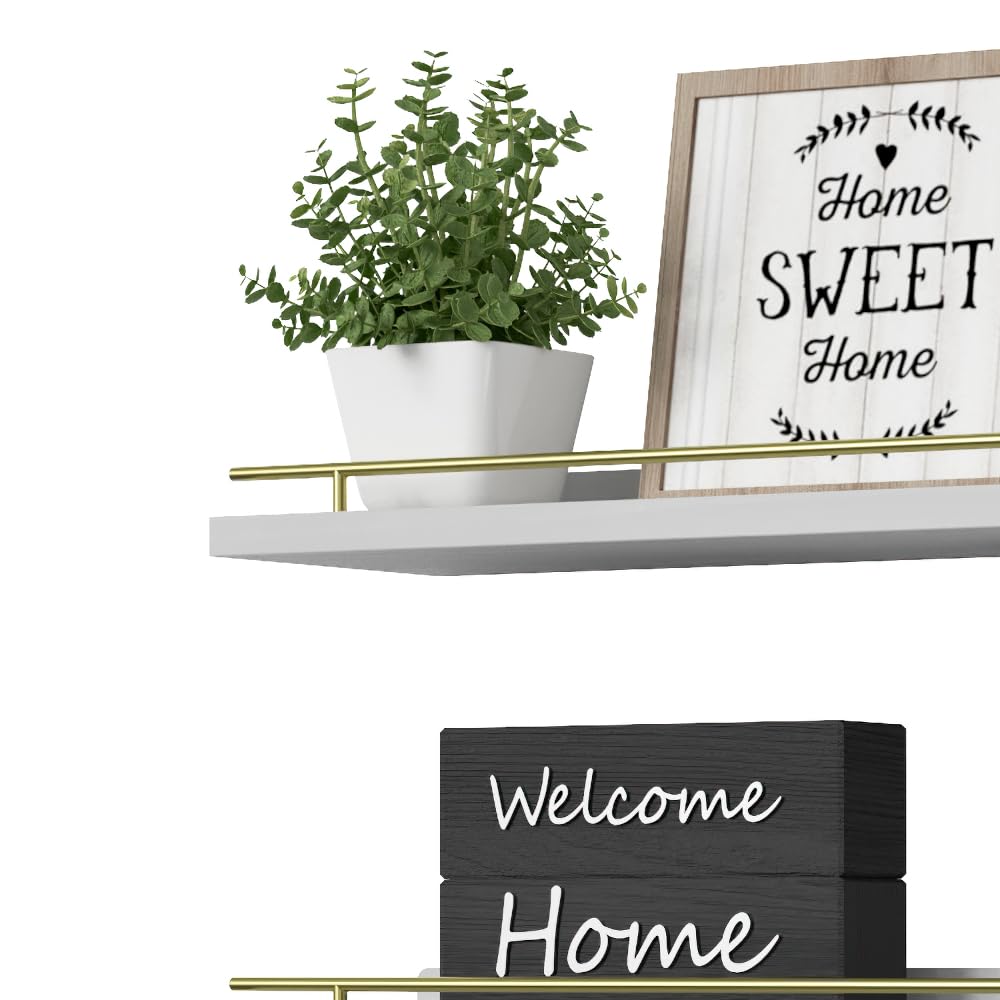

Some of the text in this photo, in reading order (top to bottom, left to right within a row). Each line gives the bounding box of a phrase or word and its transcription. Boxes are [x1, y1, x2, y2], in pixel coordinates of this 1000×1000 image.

[818, 173, 951, 221] Home
[757, 238, 994, 320] SWEET
[804, 335, 938, 384] Home
[490, 766, 783, 831] Welcome
[495, 885, 781, 978] Home
